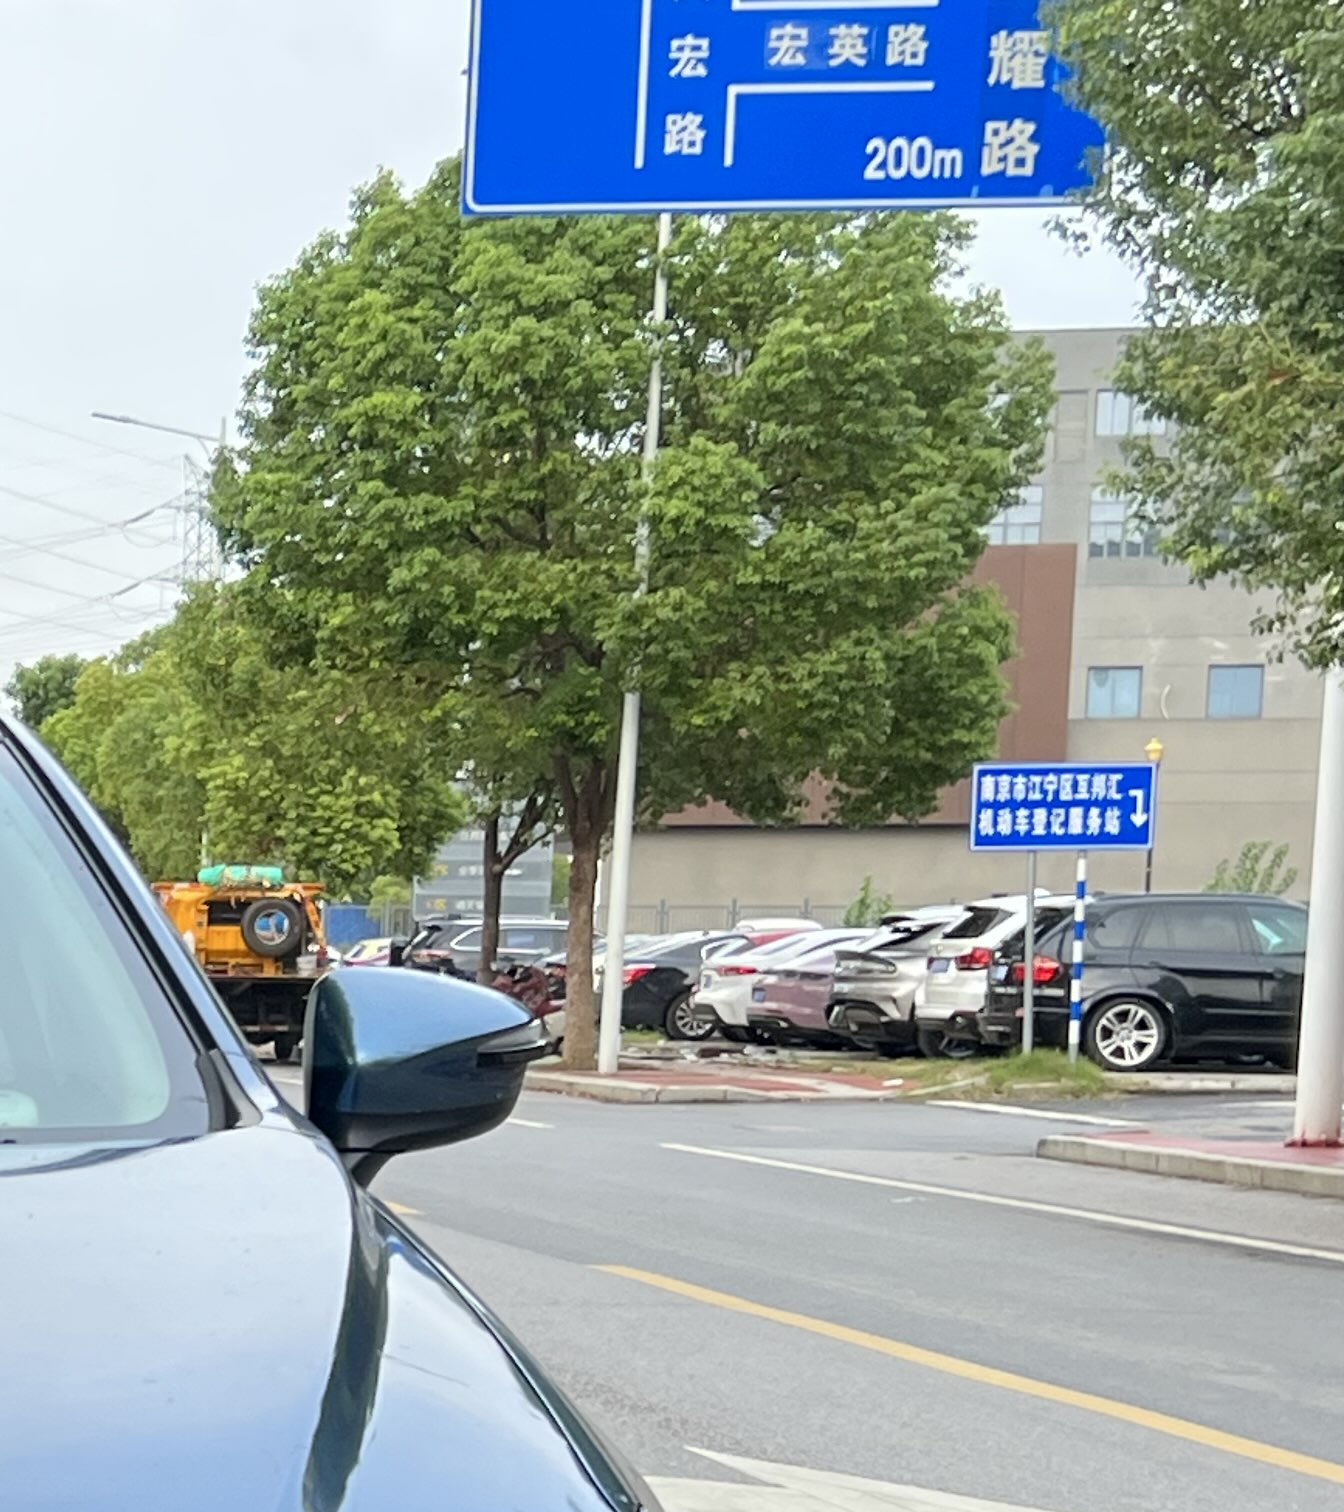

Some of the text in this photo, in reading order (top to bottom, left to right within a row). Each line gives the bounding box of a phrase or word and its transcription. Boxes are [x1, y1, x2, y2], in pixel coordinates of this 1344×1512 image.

[768, 23, 929, 68] 宏英路
[663, 0, 711, 157] 宏路
[863, 137, 962, 180] 200m
[978, 806, 1121, 836] 机动车登记服务站
